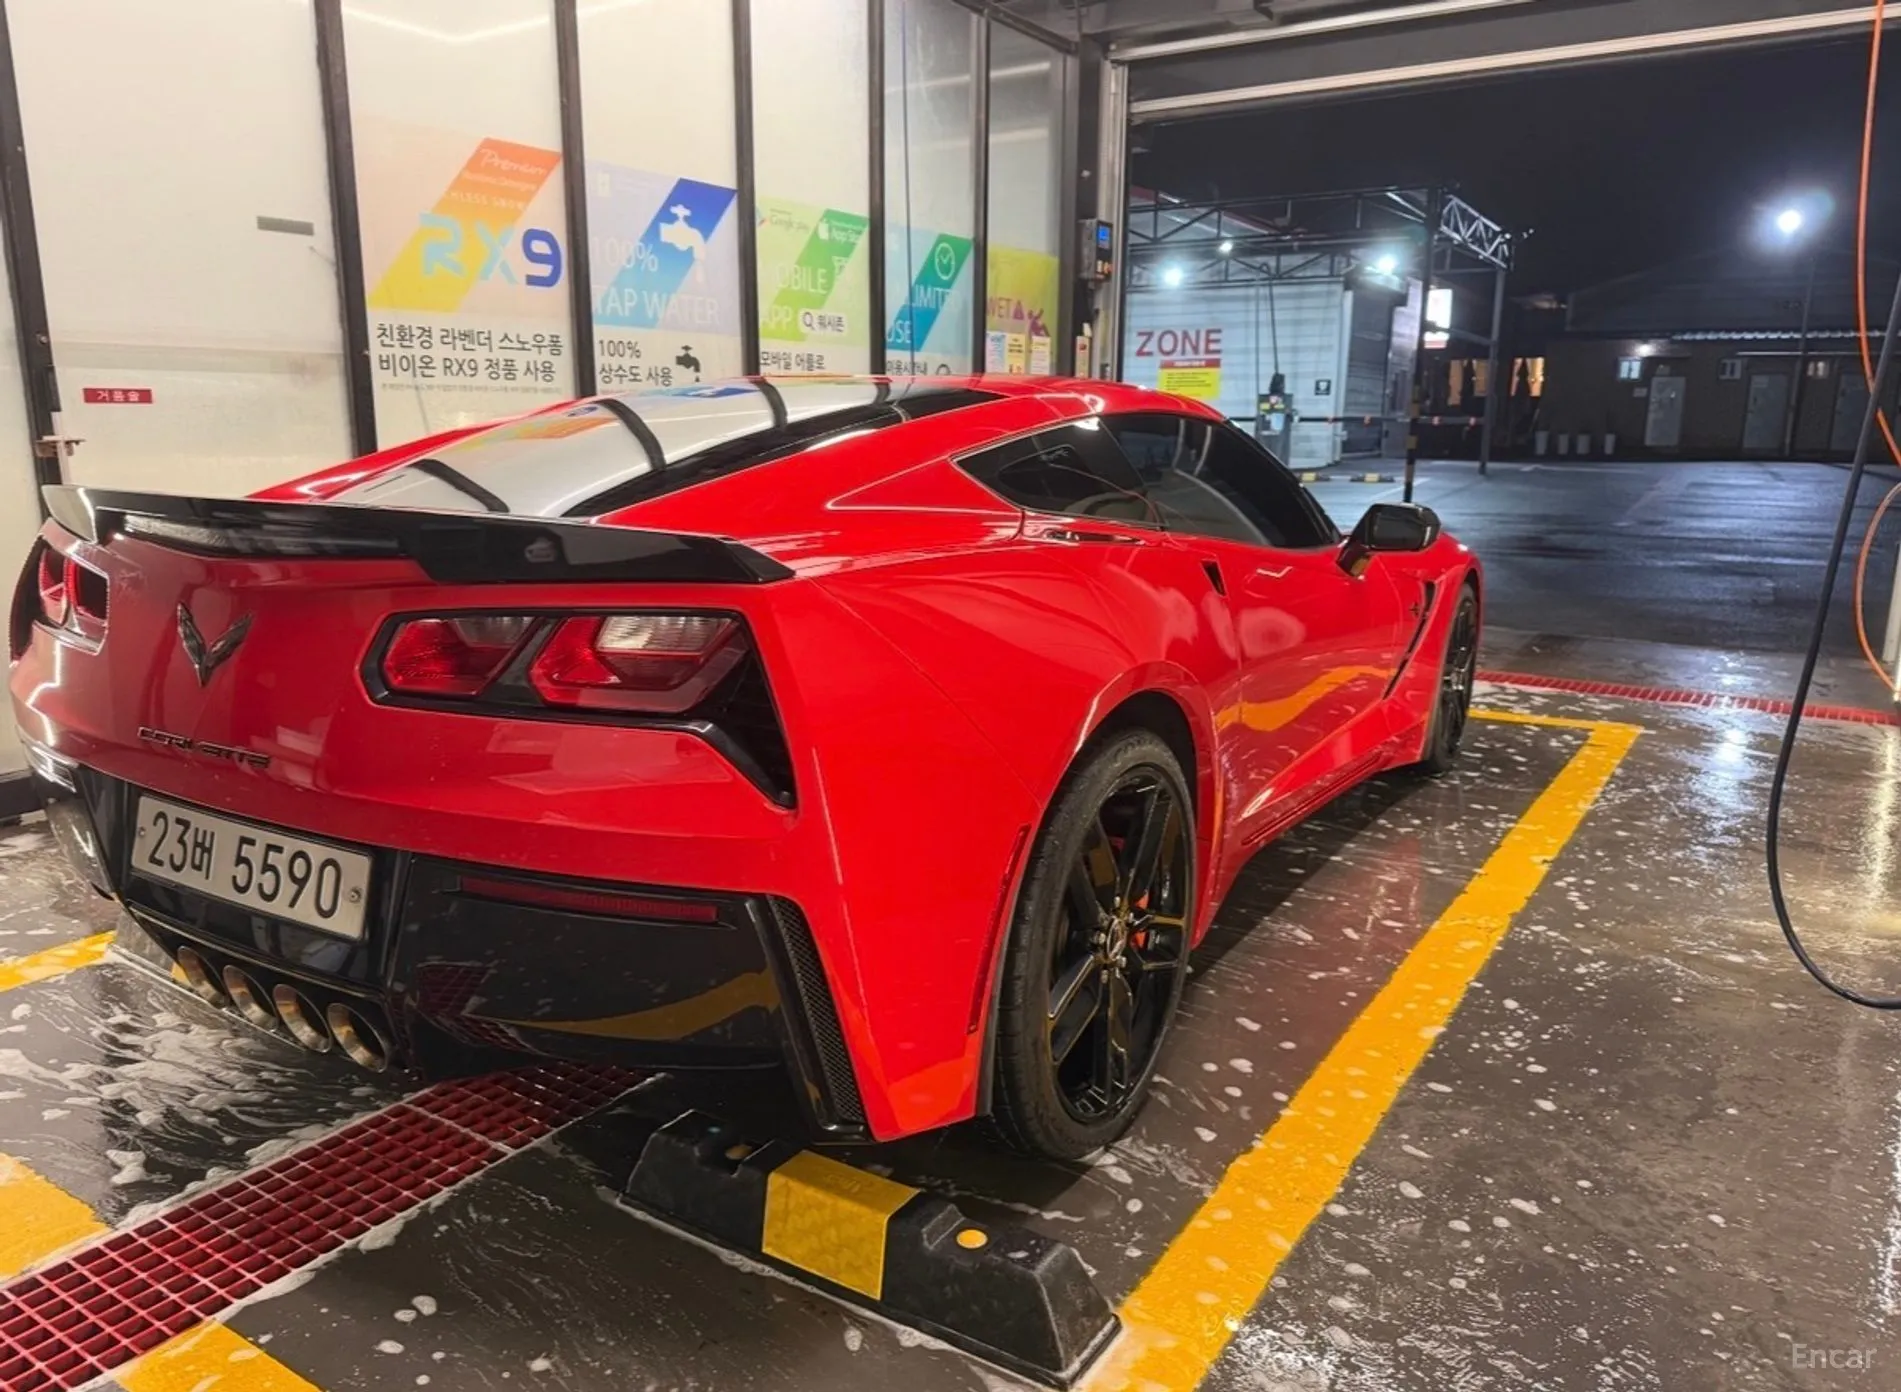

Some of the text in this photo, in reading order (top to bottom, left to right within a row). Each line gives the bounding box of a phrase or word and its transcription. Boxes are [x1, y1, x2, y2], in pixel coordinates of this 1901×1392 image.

[418, 212, 563, 288] RX9
[592, 285, 721, 325] TAP WATER
[376, 323, 564, 357] 친환경 라벤더 스노우폼
[598, 339, 642, 359] 100%
[1134, 328, 1223, 357] ZONE
[378, 353, 557, 383] 비이온 RX9 정품 사용
[598, 363, 674, 387] 상수도 사용
[760, 351, 793, 370] 모바일
[147, 810, 343, 920] 23버 5590
